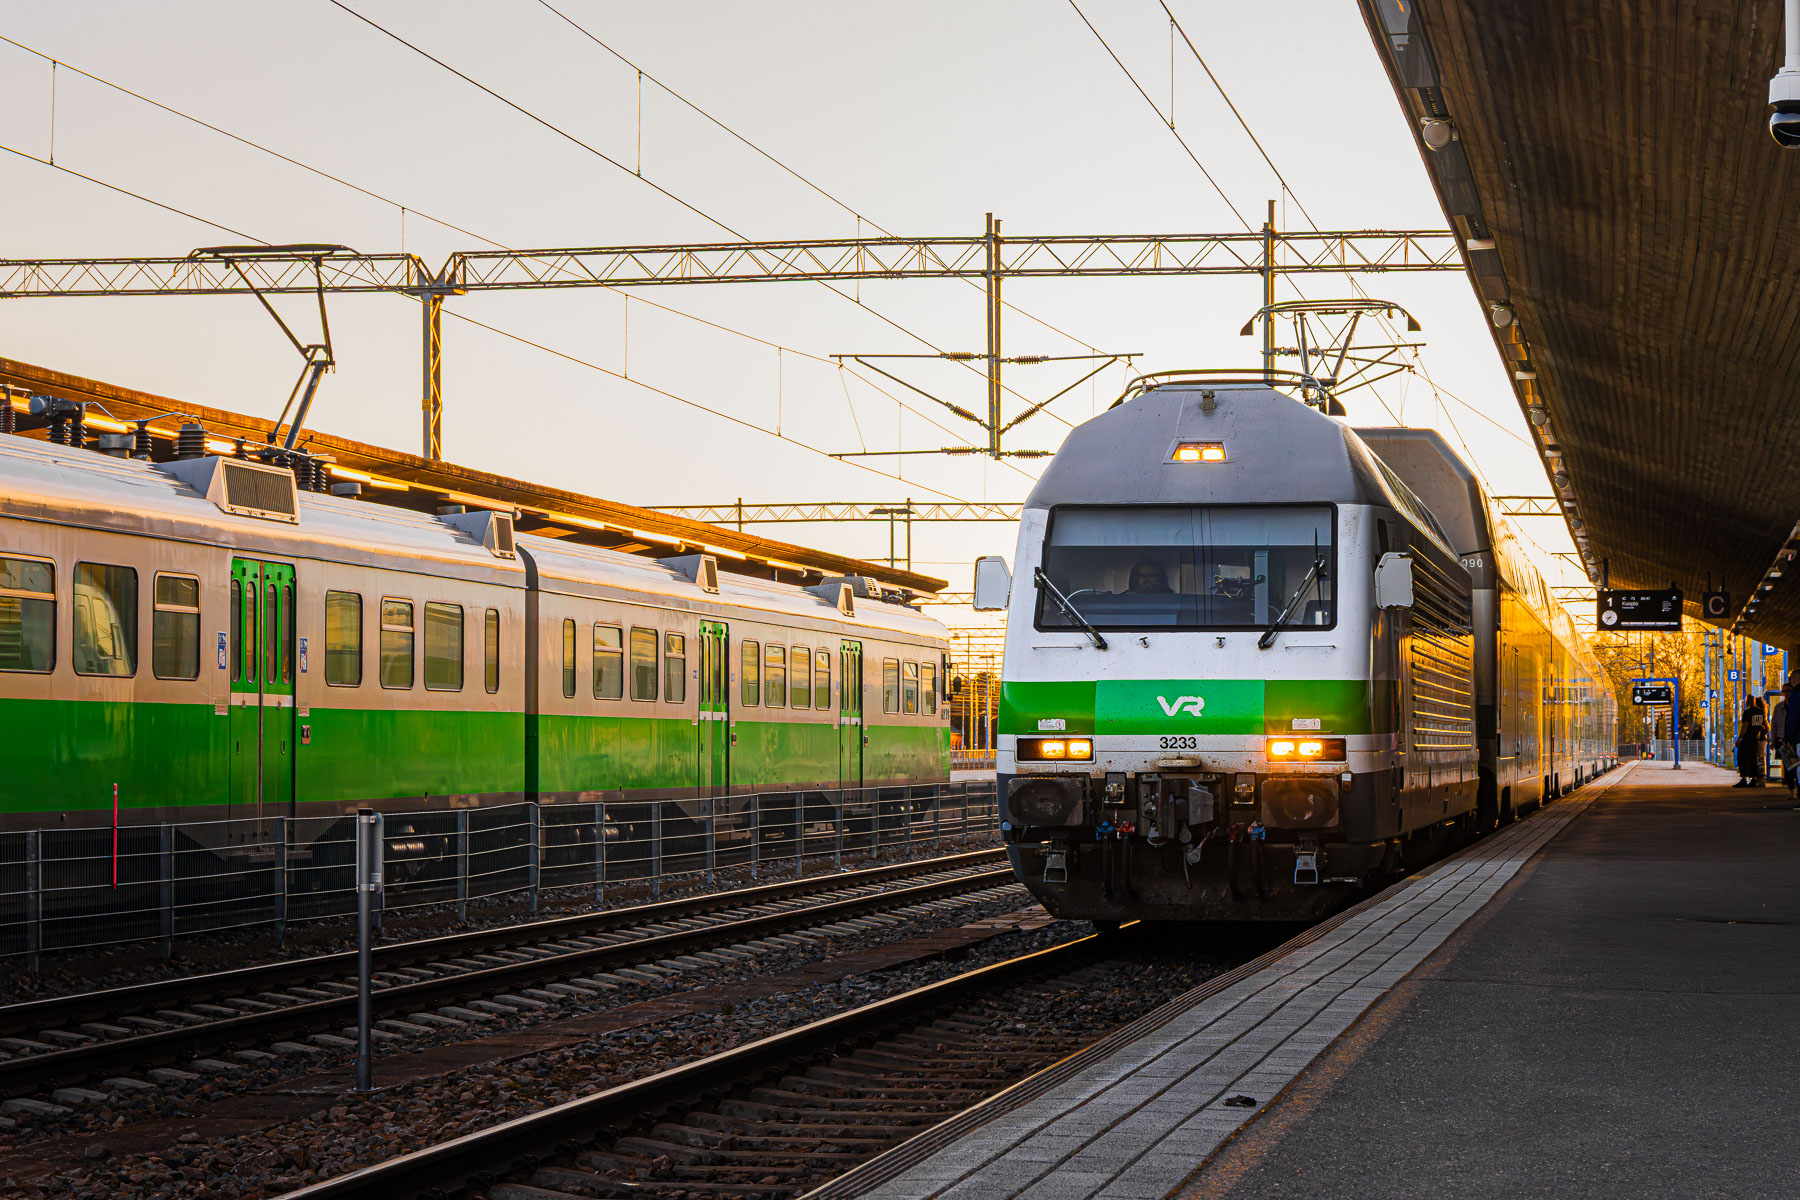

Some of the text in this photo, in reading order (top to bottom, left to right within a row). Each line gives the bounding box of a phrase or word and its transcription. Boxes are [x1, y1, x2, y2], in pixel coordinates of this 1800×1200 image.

[1607, 597, 1613, 607] 1
[1709, 596, 1725, 615] C
[1730, 671, 1738, 680] B
[1156, 696, 1205, 717] VR
[1160, 736, 1197, 749] 3233
